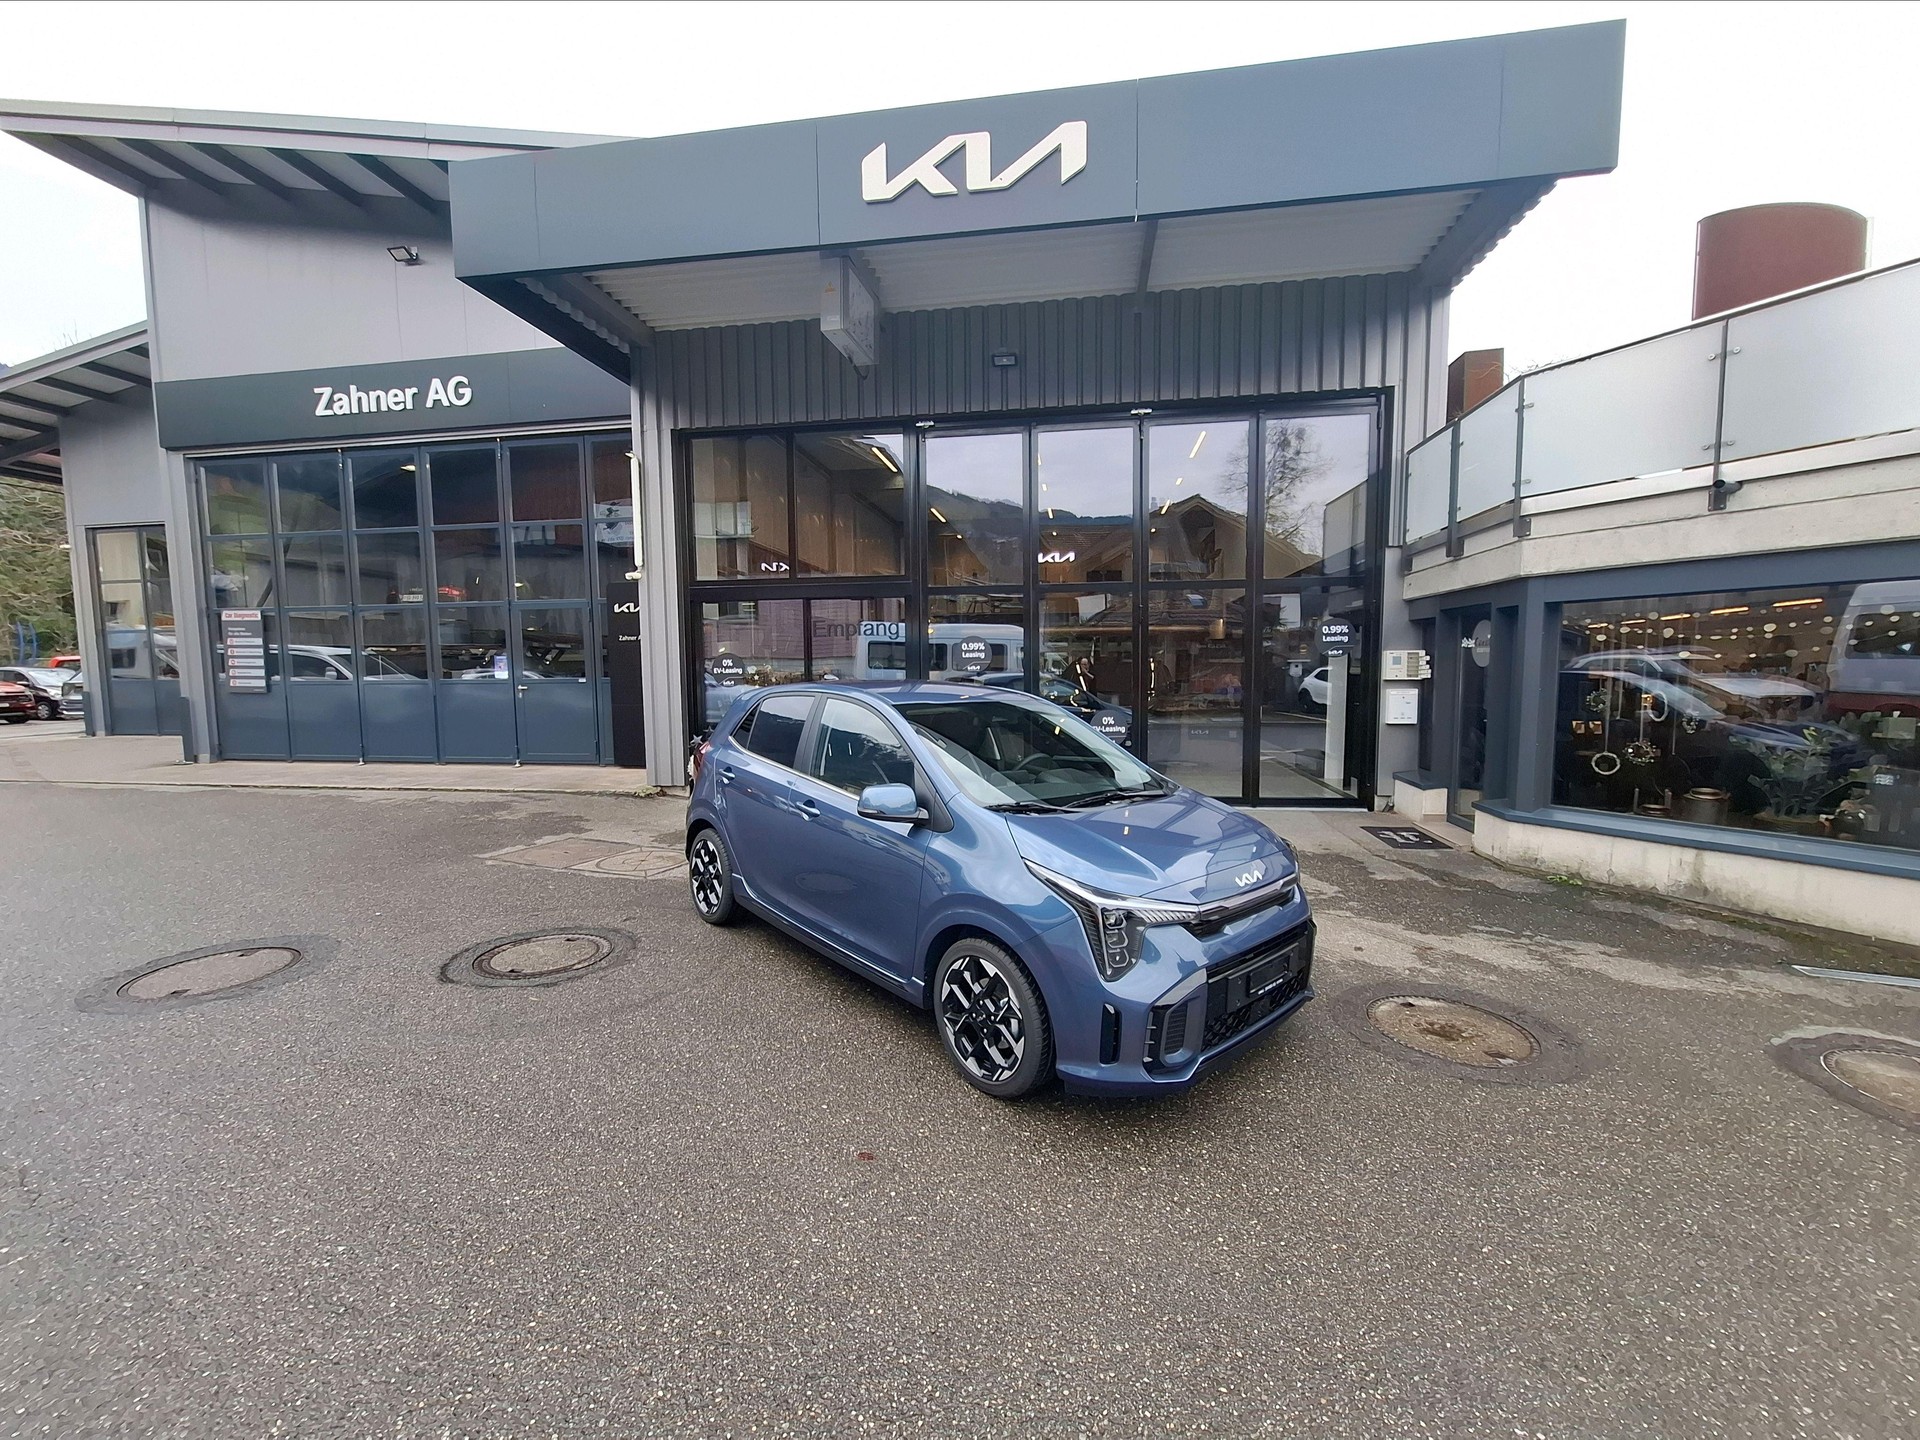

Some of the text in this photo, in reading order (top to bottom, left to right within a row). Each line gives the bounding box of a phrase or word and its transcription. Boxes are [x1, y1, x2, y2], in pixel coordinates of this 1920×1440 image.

[861, 120, 1087, 203] KIA
[313, 375, 473, 417] Zahner AG
[1037, 551, 1076, 563] KIA
[812, 619, 900, 641] Empfang
[1322, 625, 1349, 634] 0.99%
[1322, 635, 1349, 643] Leasing
[961, 642, 985, 651] 0.99%
[961, 651, 985, 659] Leasing
[722, 658, 733, 667] 0%
[1102, 716, 1115, 725] 0%
[1235, 869, 1263, 887] KIA
